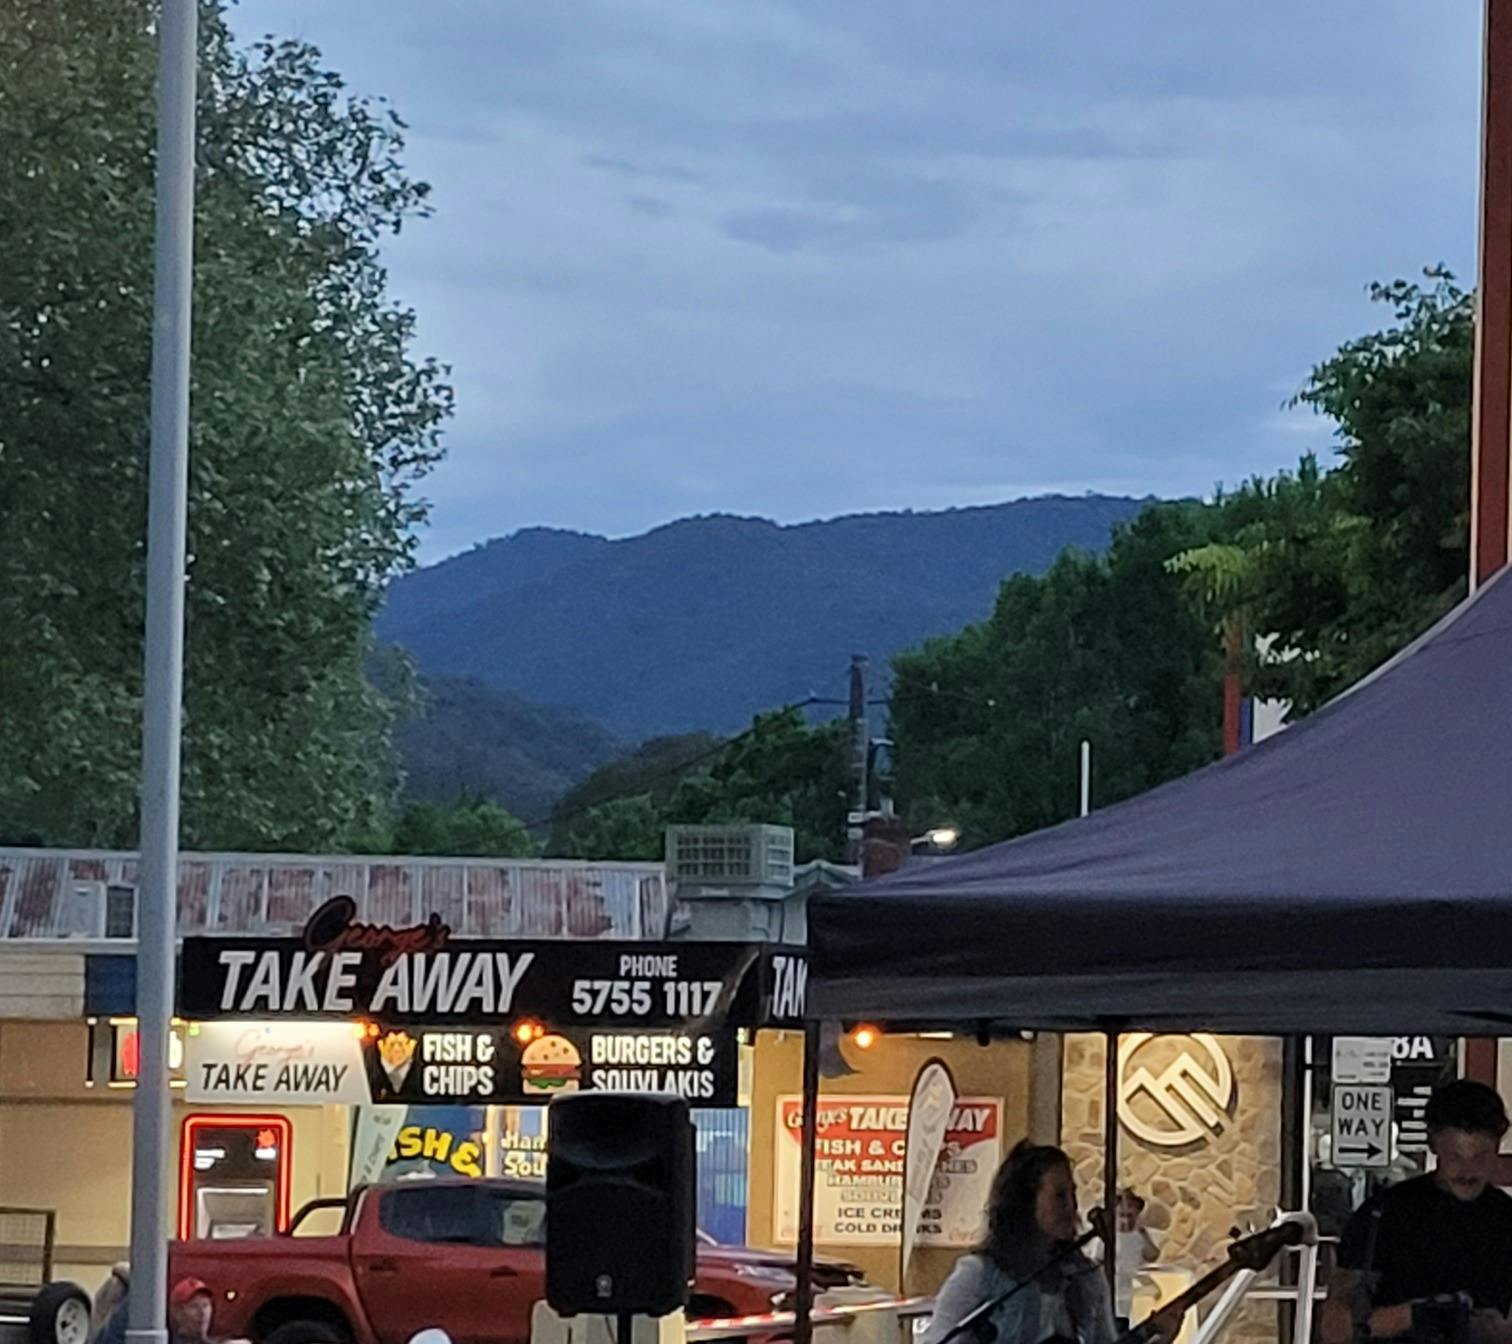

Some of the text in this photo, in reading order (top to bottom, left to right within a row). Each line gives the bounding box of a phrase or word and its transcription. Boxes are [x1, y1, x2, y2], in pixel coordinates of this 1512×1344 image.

[619, 955, 678, 977] PHONE
[218, 951, 534, 1013] TAKE AWAY
[572, 980, 723, 1017] 5755 1117
[422, 1034, 495, 1064] FISH &
[591, 1035, 715, 1065] BURGERS &
[201, 1064, 348, 1093] TAKE AWAY
[423, 1065, 495, 1097] CHIPS
[1342, 1091, 1383, 1111] ONE
[1338, 1118, 1384, 1136] WAY
[868, 1140, 886, 1156] &
[838, 1207, 864, 1219] ICE
[834, 1222, 877, 1234] COLD
